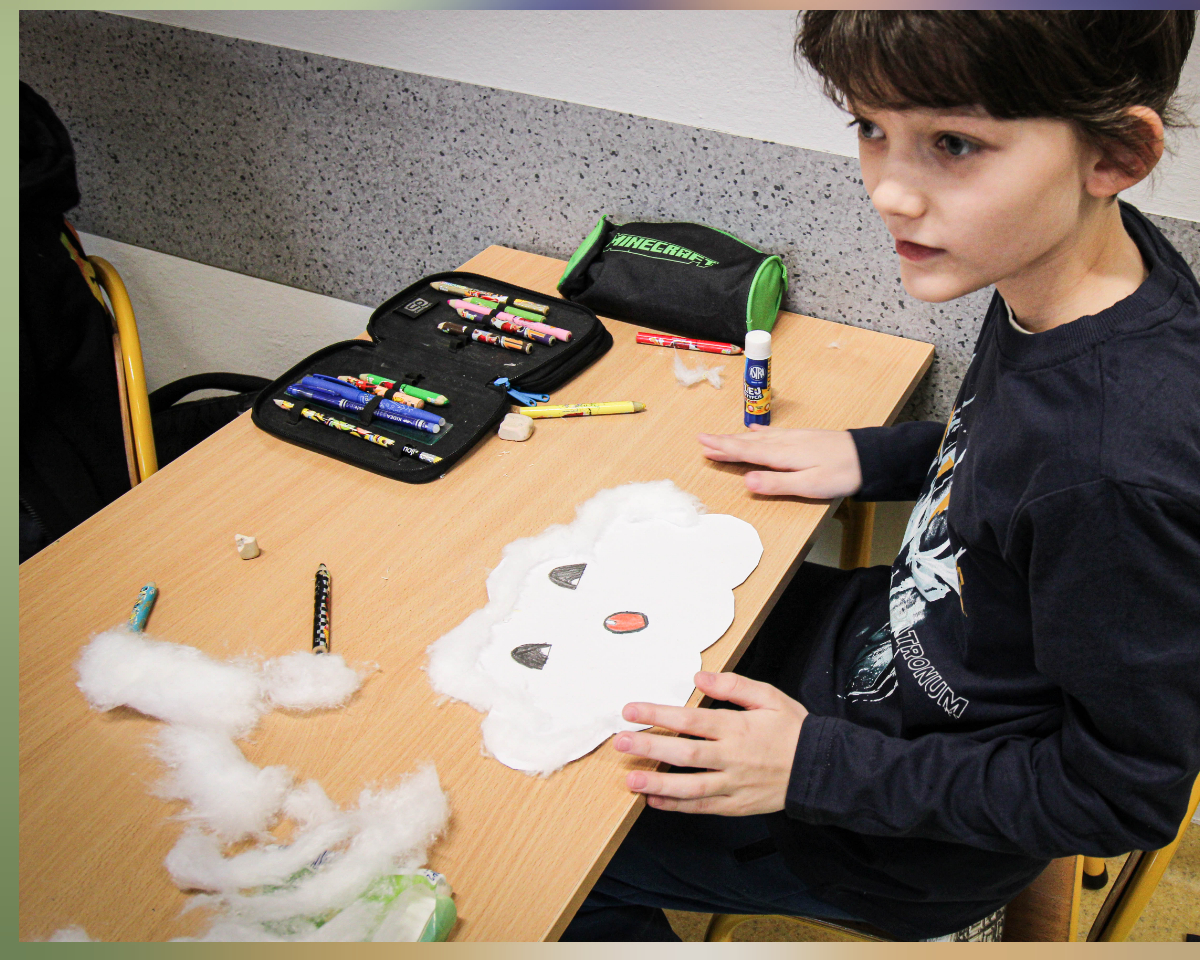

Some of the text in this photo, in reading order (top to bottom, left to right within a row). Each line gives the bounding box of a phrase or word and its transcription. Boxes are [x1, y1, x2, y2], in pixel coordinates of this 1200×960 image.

[604, 233, 719, 268] MINECRAFT
[749, 366, 765, 381] ASTRA
[744, 385, 762, 396] LEJ
